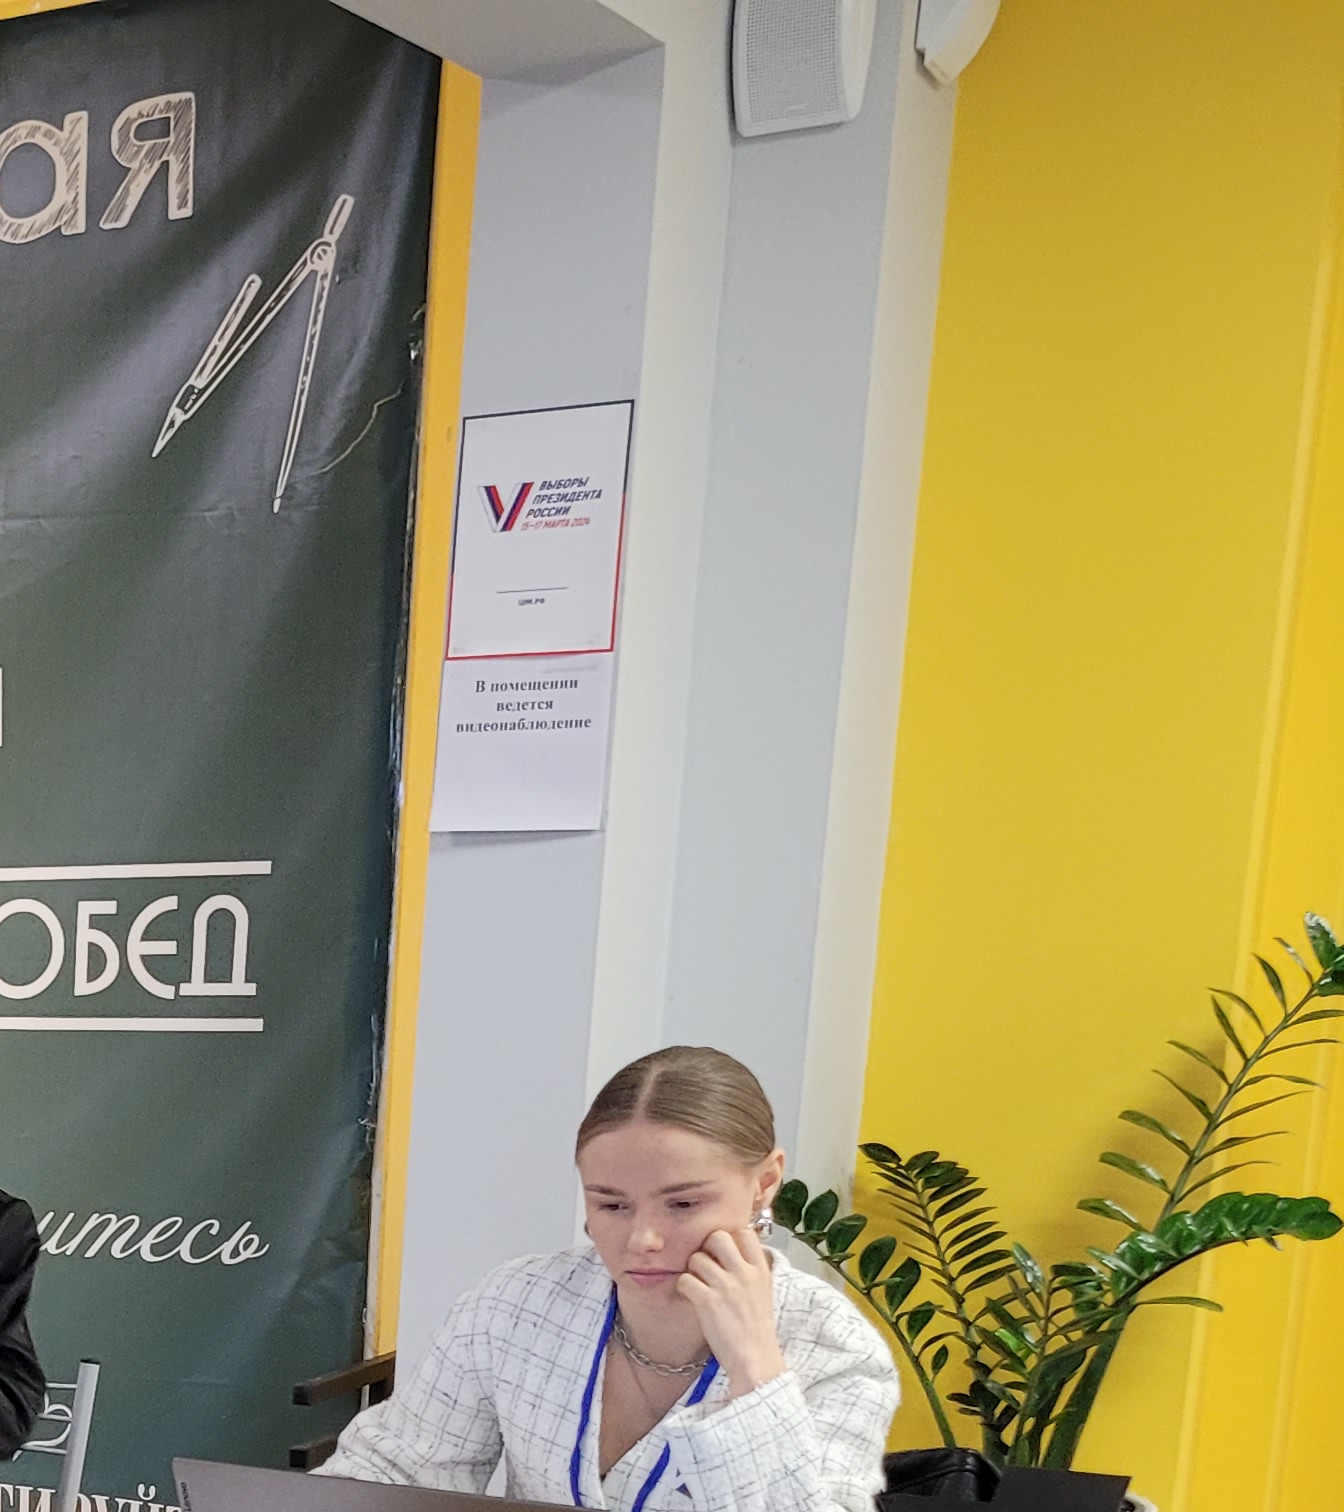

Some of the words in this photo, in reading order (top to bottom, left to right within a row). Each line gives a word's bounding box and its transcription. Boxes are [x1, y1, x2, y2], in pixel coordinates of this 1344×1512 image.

[539, 477, 589, 491] ВЫБОРЫ
[532, 489, 602, 505] ПРЕЗИДЕНТА
[525, 505, 571, 519] РОССИИ
[475, 680, 485, 693] В
[490, 679, 578, 692] помещении
[496, 700, 553, 712] ведется
[456, 718, 592, 733] видеонаблюдение
